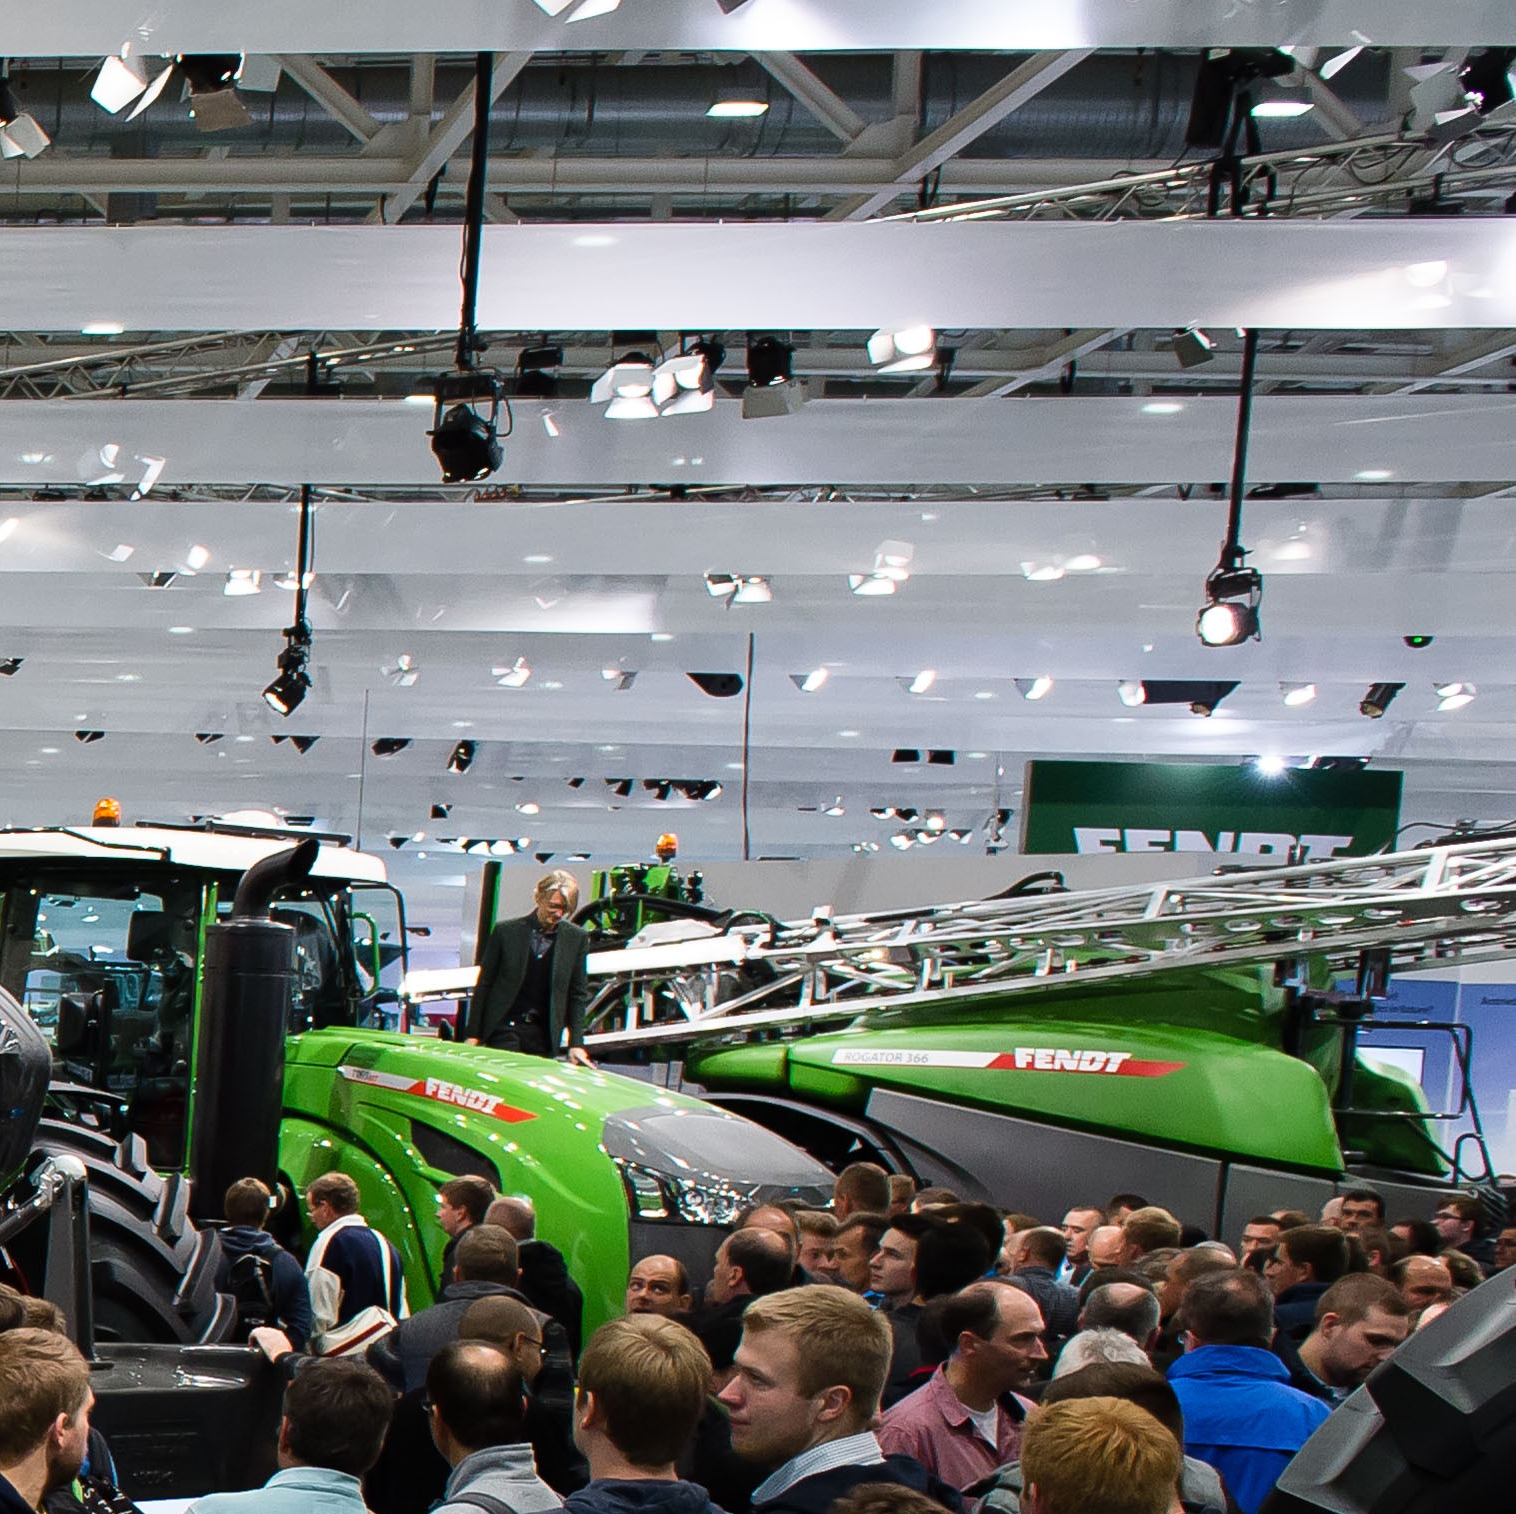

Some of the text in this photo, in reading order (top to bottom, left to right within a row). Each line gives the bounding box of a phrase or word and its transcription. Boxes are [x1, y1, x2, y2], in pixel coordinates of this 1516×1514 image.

[906, 1053, 929, 1063] 366
[1014, 1048, 1132, 1073] FENDT
[425, 1076, 505, 1116] FENDT
